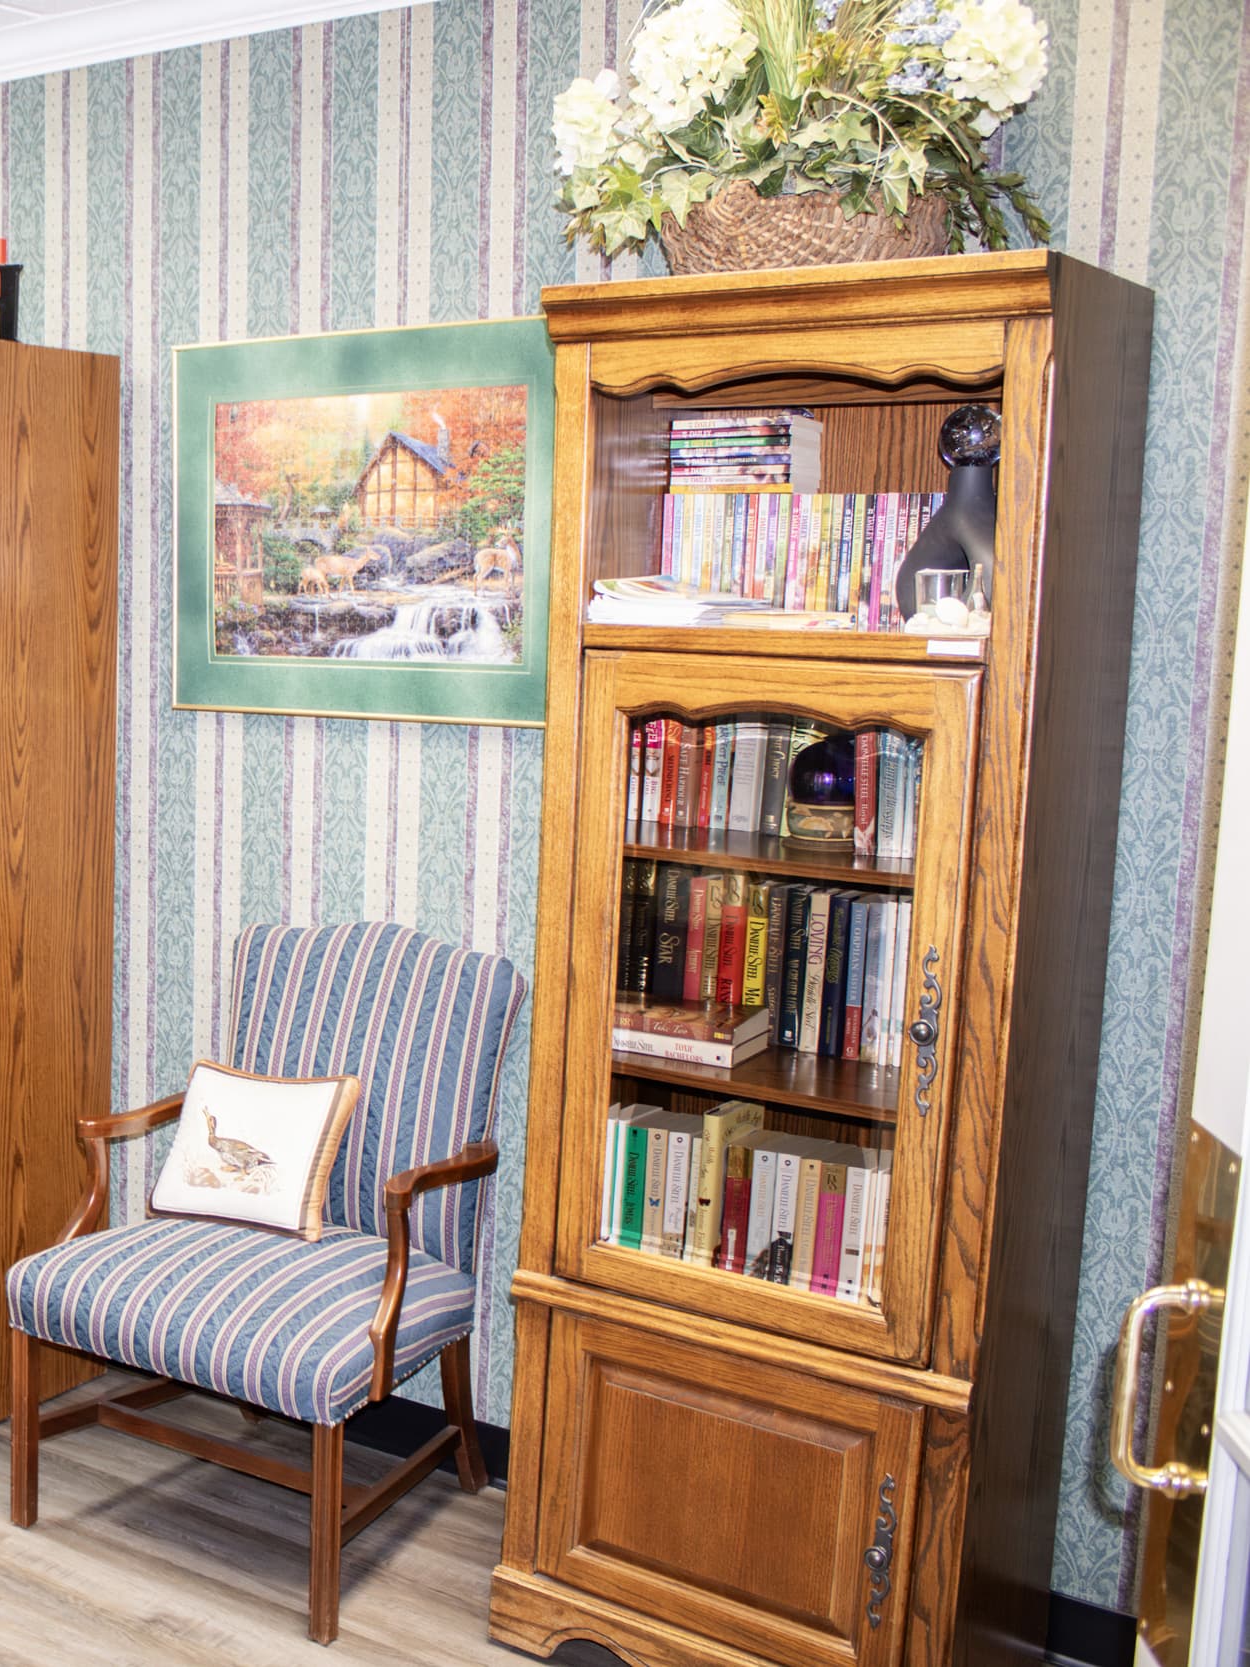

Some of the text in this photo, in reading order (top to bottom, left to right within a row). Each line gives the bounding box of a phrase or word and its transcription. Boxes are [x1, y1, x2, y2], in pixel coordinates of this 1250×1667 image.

[861, 736, 869, 777] DANIELLE
[657, 870, 681, 964] DANIELLE STEEL STAR
[771, 898, 782, 943] DANIELLE
[748, 921, 765, 956] DANIELLE
[808, 913, 826, 965] LOVING
[852, 927, 862, 970] ORPHAN
[747, 955, 762, 981] STEEL
[805, 974, 821, 1006] Danielle
[652, 1148, 663, 1177] DANIELLE
[673, 1151, 684, 1182] DANIELLE
[651, 1179, 661, 1197] STEEL
[670, 1184, 682, 1204] STEEL
[779, 1175, 791, 1207] DANIELLE
[804, 1179, 817, 1214] DANIELLE
[778, 1209, 789, 1228] STEEL
[849, 1184, 863, 1235] DANIELLE STEEL
[801, 1215, 814, 1237] STEEL
